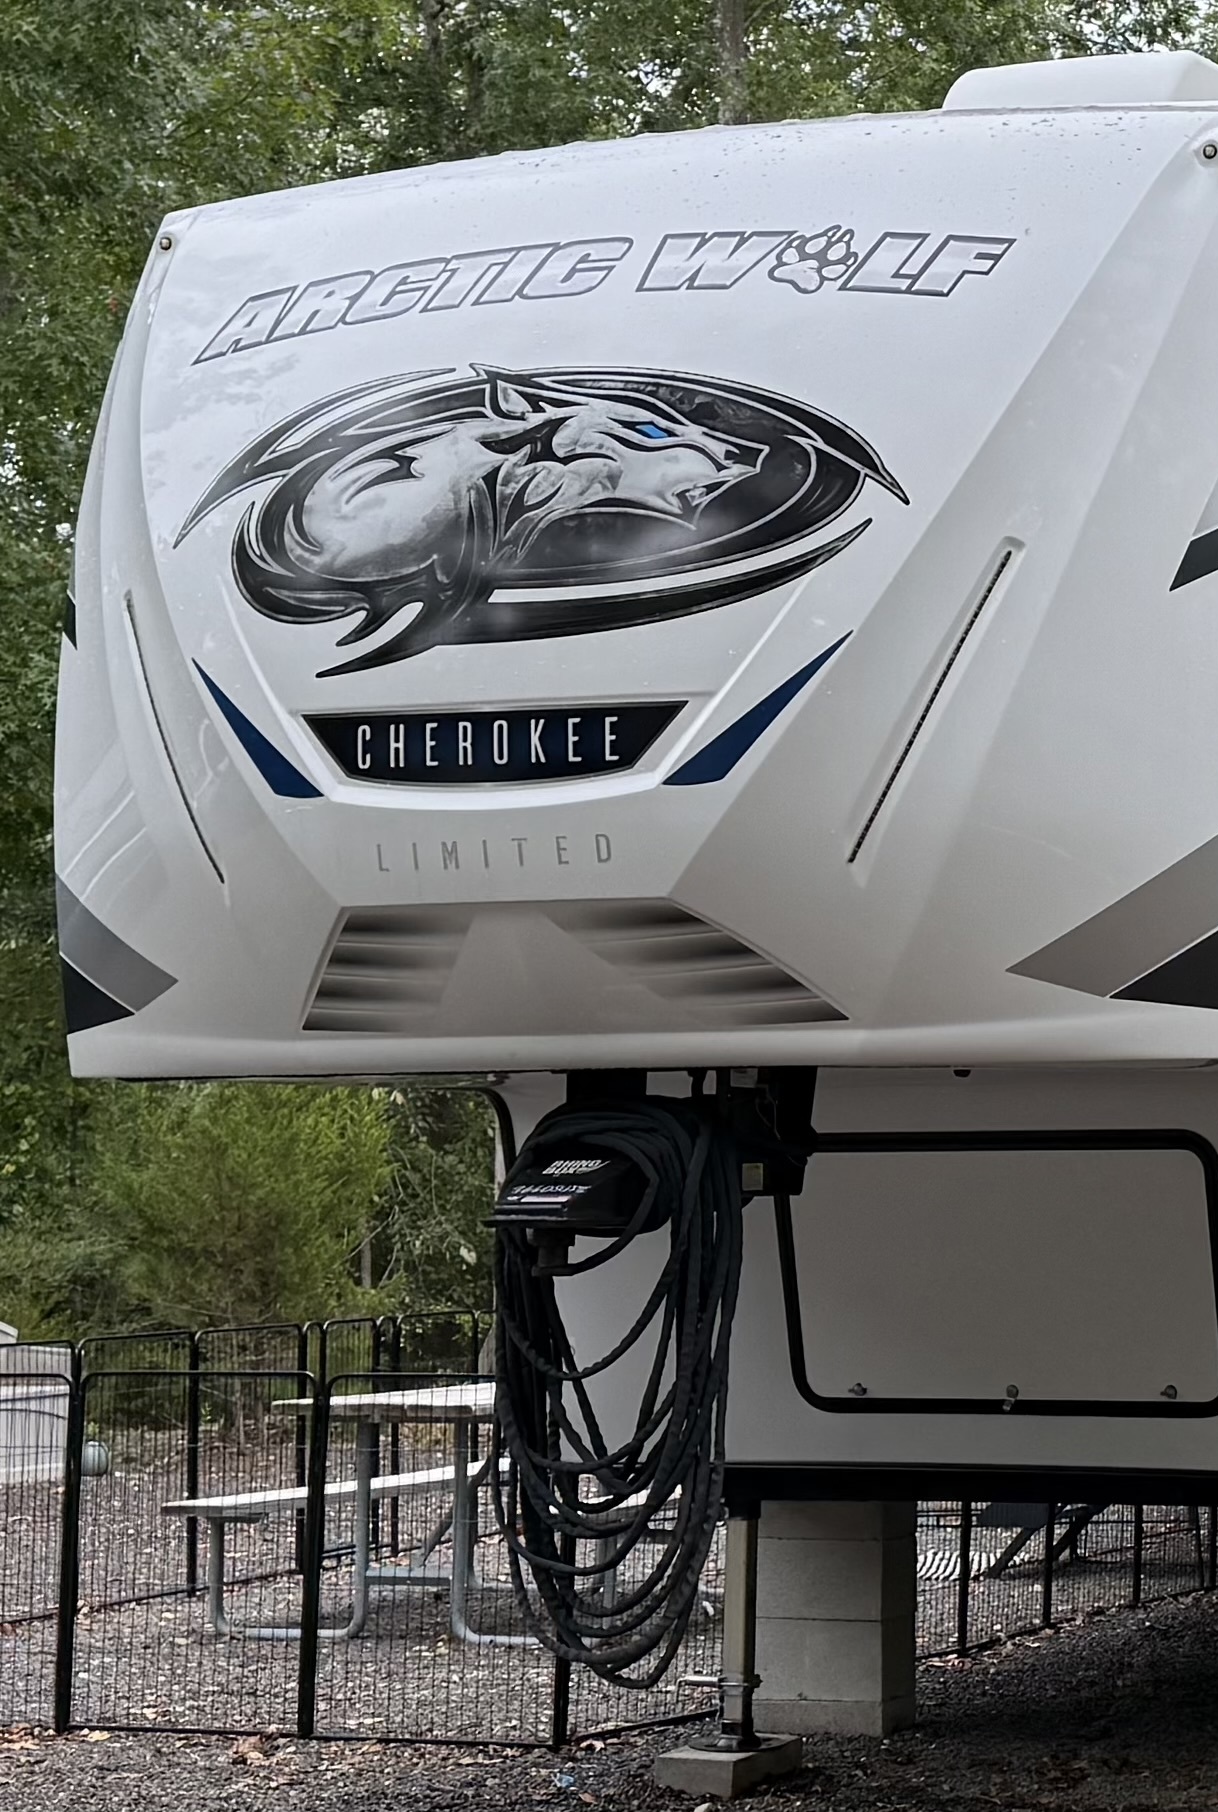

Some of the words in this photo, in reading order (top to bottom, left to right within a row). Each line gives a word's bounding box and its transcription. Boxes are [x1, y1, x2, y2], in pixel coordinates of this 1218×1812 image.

[193, 237, 633, 365] ARCTIC
[356, 715, 621, 770] CHEROKEE
[376, 832, 613, 873] LIMITED
